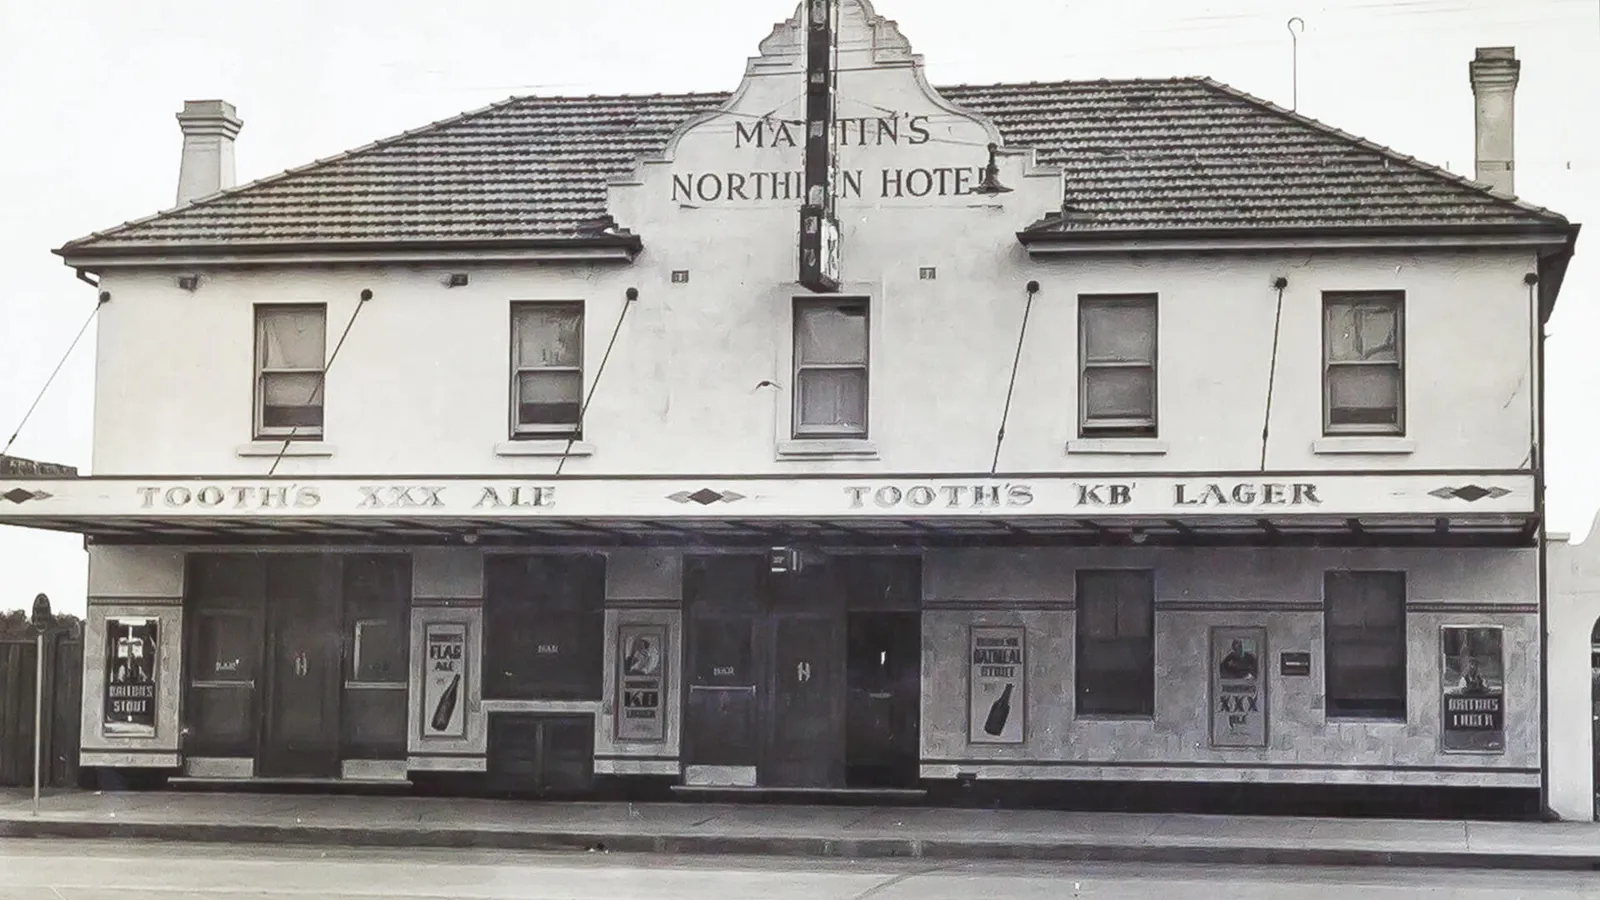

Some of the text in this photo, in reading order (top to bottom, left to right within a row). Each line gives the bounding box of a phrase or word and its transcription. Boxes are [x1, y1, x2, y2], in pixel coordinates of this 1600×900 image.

[735, 112, 930, 148] MATIN'S
[672, 168, 862, 201] NORTHN
[136, 484, 556, 509] TOOTH'S XXX ALE
[844, 483, 1034, 508] TOOTH'S
[1173, 483, 1323, 508] LAGER
[114, 700, 146, 712] STOUT
